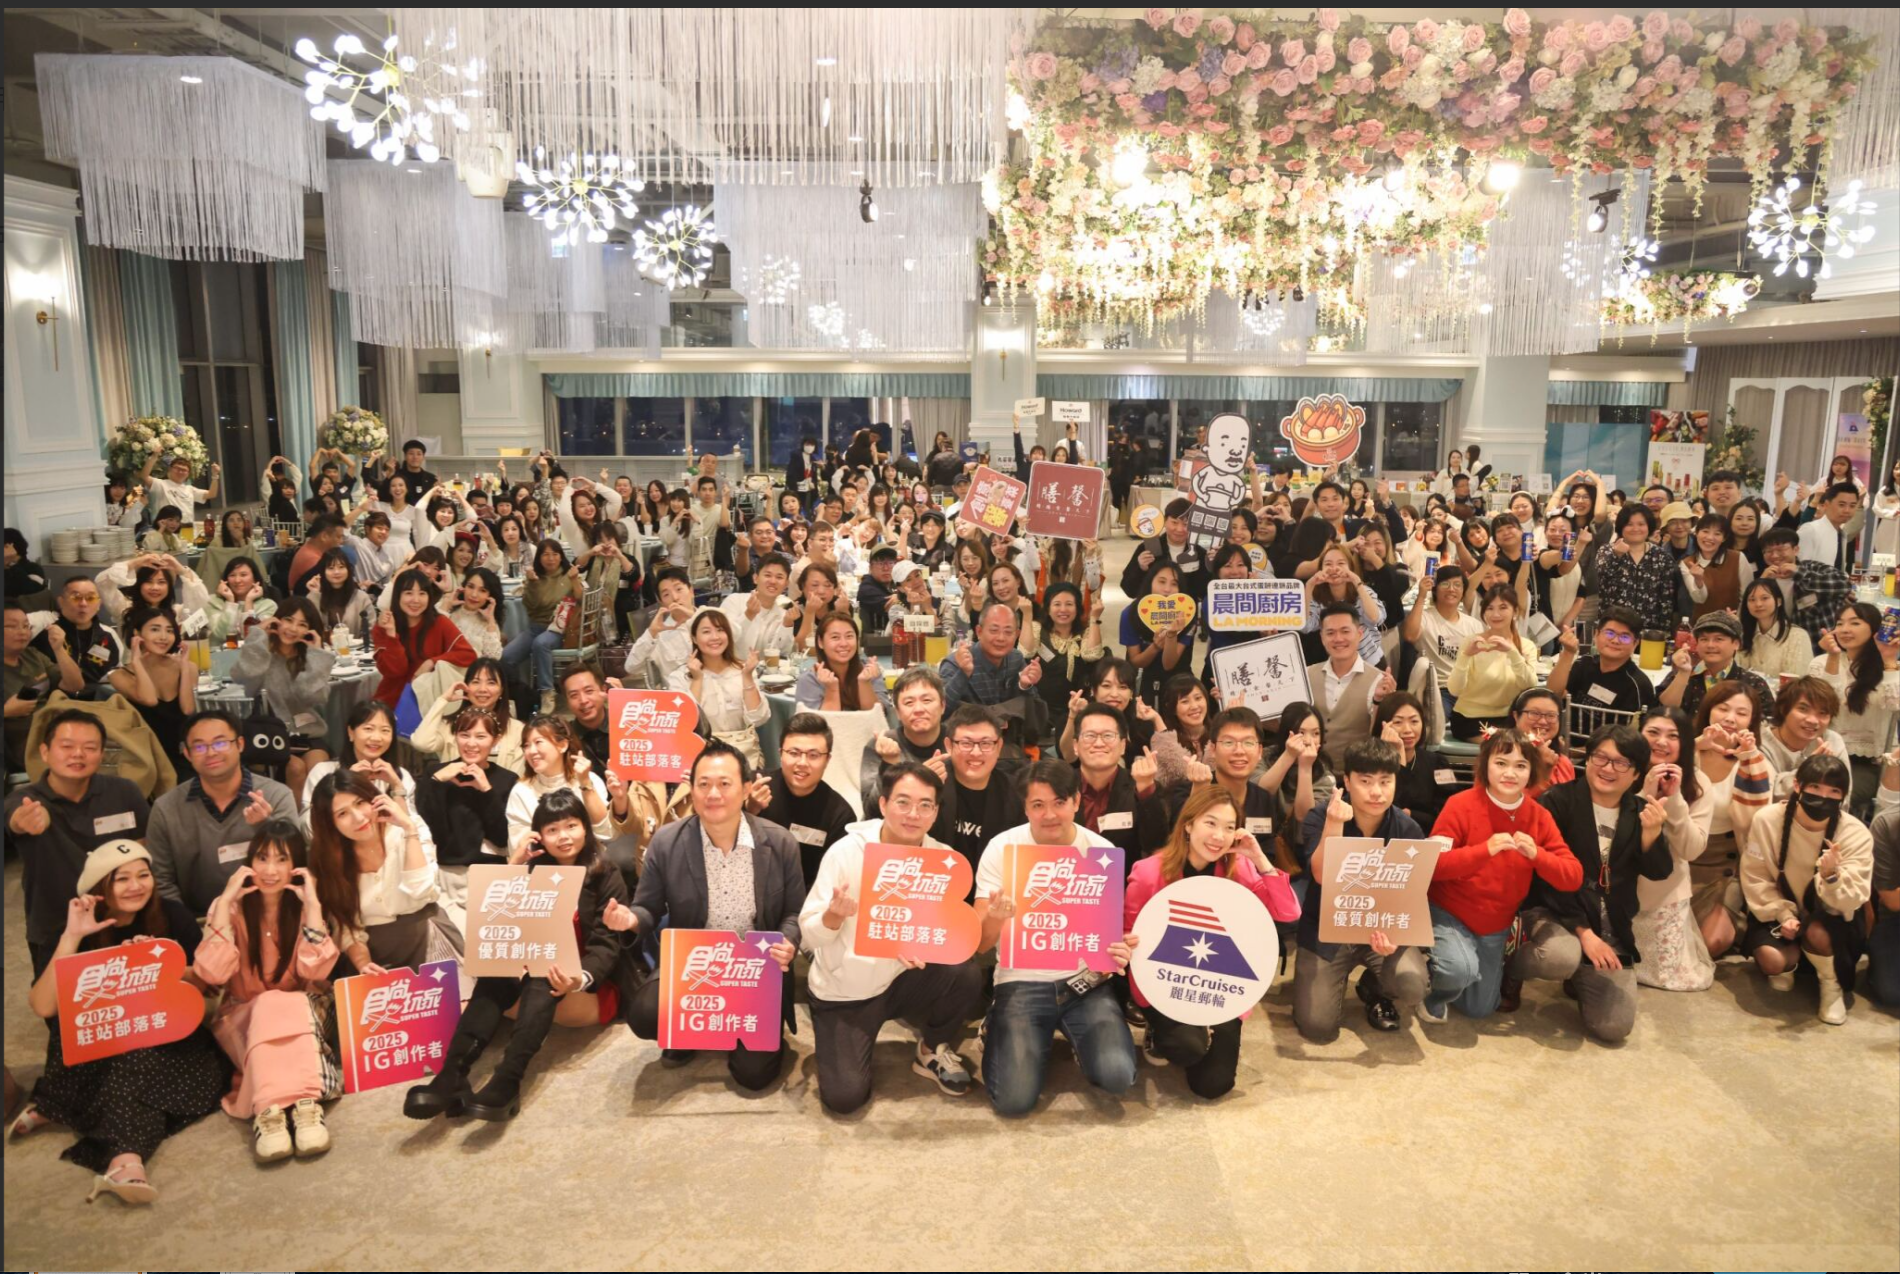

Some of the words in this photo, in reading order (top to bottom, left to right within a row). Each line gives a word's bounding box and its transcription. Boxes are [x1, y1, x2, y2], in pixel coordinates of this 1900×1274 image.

[1042, 481, 1089, 506] 膳馨
[1156, 600, 1176, 610] 我愛
[1212, 591, 1302, 615] 晨間廚房
[1213, 616, 1234, 627] LA
[1236, 616, 1302, 627] MORNING
[1231, 654, 1288, 686] 膳馨
[623, 740, 648, 750] 2025
[619, 752, 682, 768] 駐站部落客
[116, 844, 130, 854] C
[1061, 897, 1080, 905] SUPER
[1082, 897, 1100, 906] TASTE
[1338, 896, 1370, 908] 2025
[876, 908, 906, 920] 2025
[1028, 914, 1062, 928] 2025
[1333, 912, 1411, 929] 優質創作者
[484, 926, 515, 939] 2025
[867, 922, 947, 946] 駐站部落客
[478, 942, 558, 960] 優質創作者
[720, 980, 738, 988] SUPER
[739, 980, 758, 988] TASTE
[1156, 968, 1246, 996] StarCruises
[116, 986, 136, 998] SUPER
[137, 984, 157, 994] TASTE
[1169, 986, 1226, 1008] 麗星郵輪
[685, 996, 720, 1010] 2025
[82, 1007, 118, 1026] 2025
[400, 1012, 420, 1022] SUPER
[420, 1009, 438, 1018] TASTE
[76, 1012, 168, 1046] 駐站部落客
[368, 1032, 404, 1051] 2025
